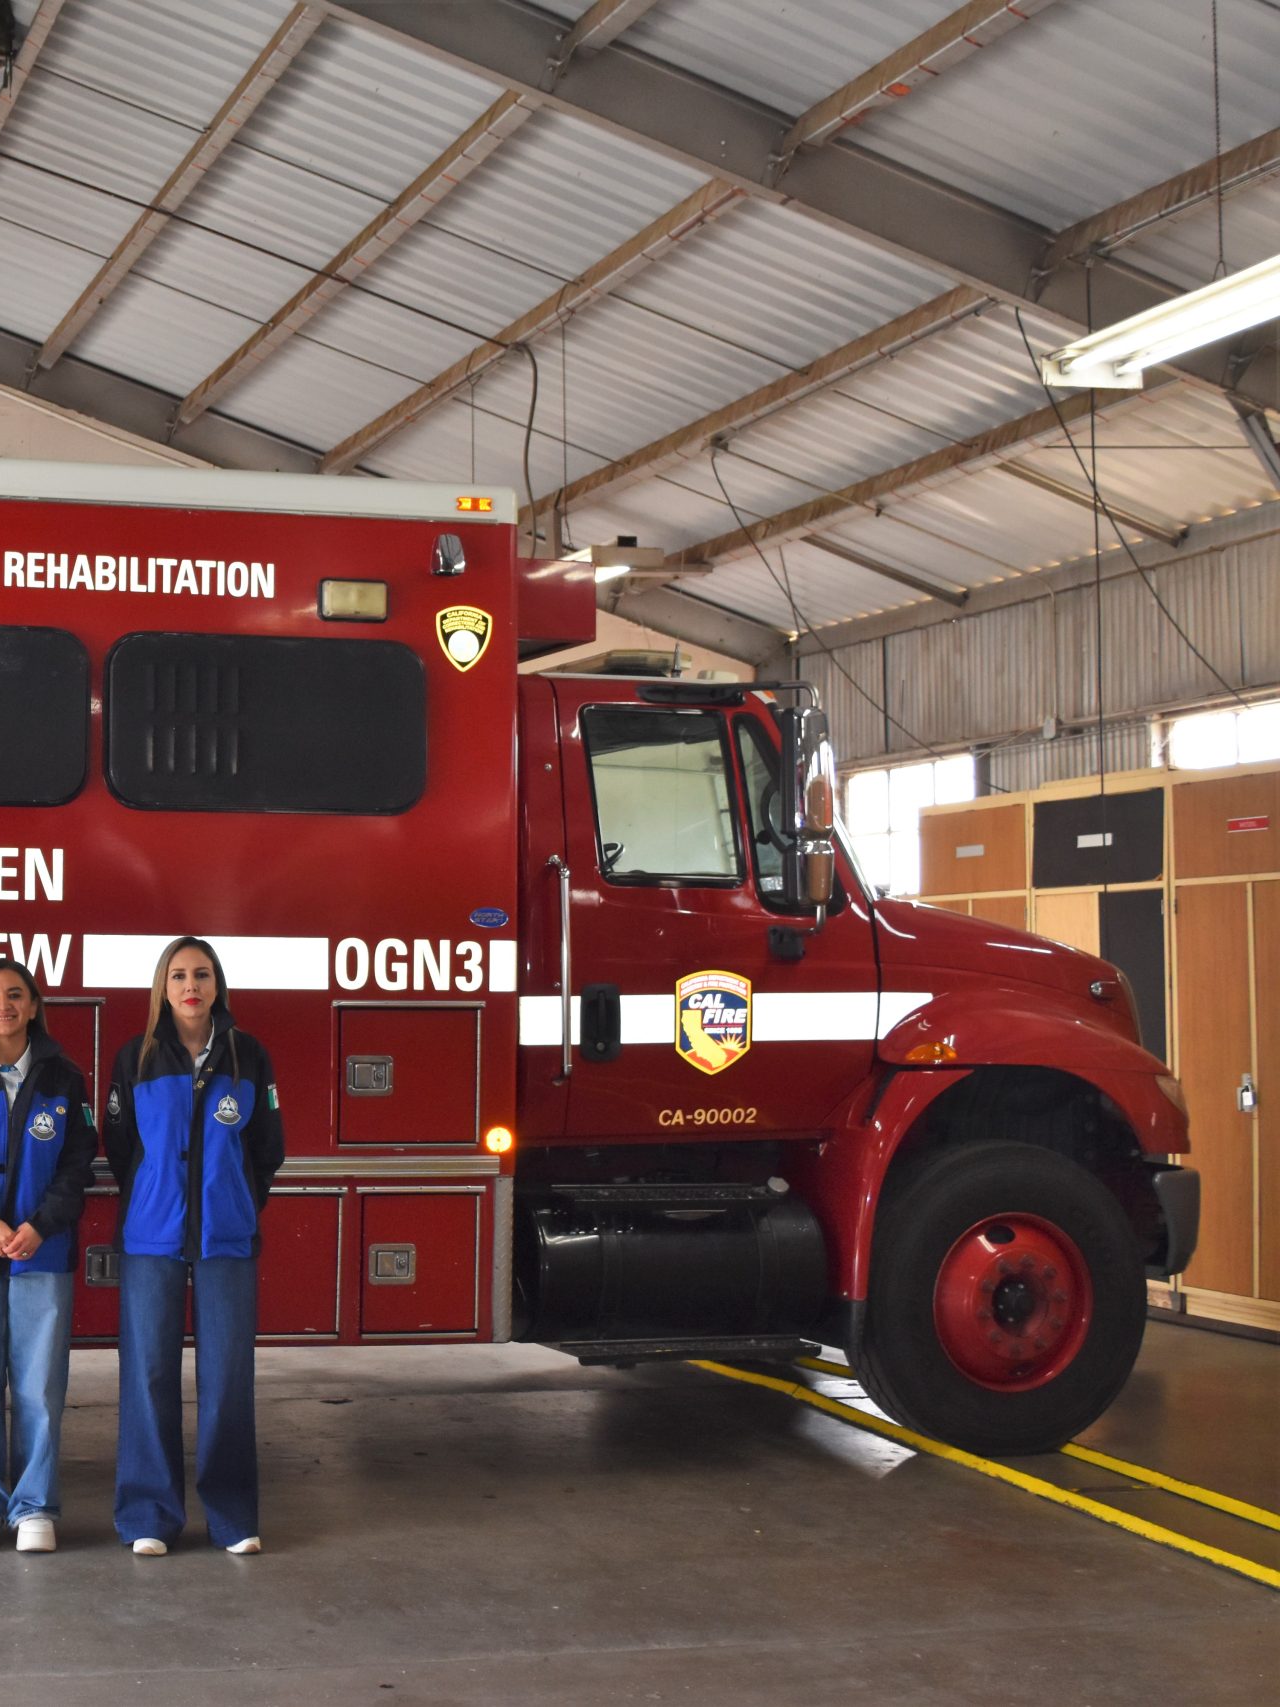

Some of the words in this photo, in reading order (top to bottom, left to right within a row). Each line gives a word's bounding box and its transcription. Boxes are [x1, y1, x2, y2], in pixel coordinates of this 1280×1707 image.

[3, 550, 275, 598] REHABILITATION
[334, 937, 484, 992] OGN3
[688, 993, 725, 1009] CAL
[702, 1008, 748, 1024] FIRE
[658, 1107, 757, 1126] CA-90002
